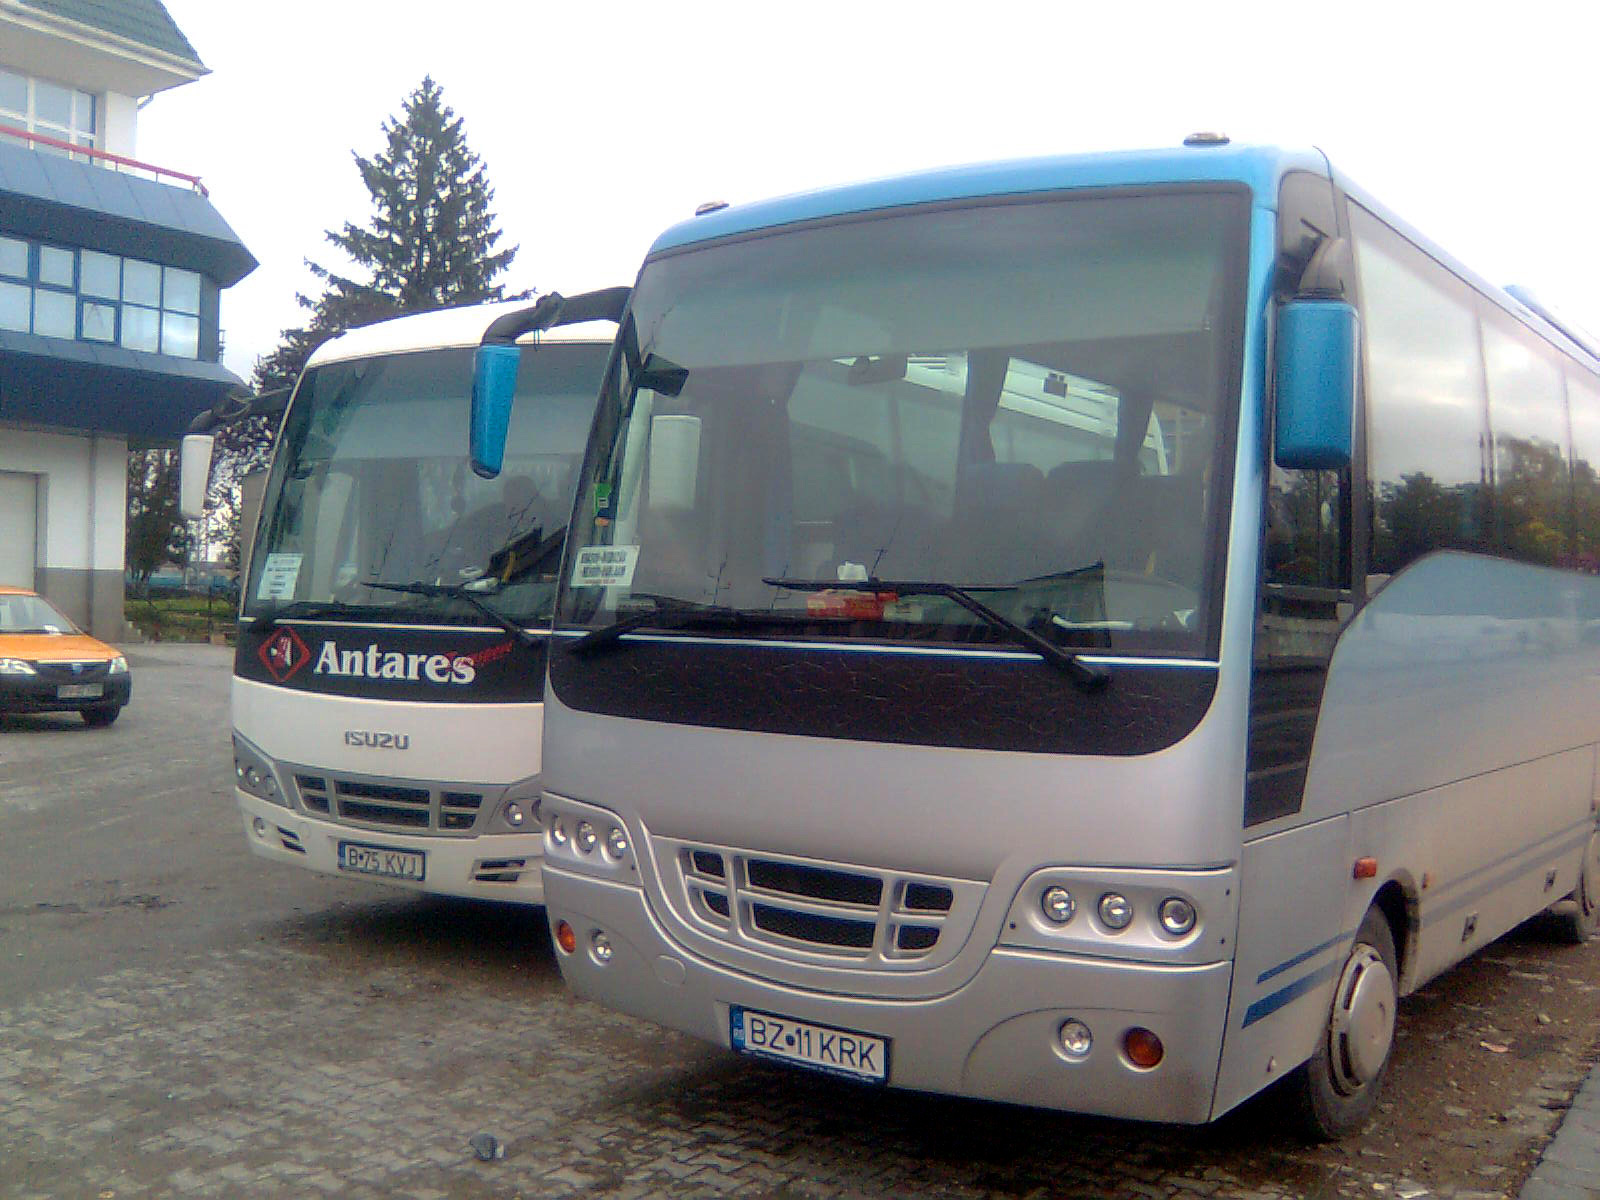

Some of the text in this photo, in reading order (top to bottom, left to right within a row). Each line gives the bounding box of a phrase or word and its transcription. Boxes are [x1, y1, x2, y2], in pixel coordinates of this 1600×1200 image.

[314, 640, 476, 684] Antares
[345, 730, 409, 750] ISUZU
[349, 847, 358, 866] B
[751, 1018, 876, 1072] BZ 11 KRK
